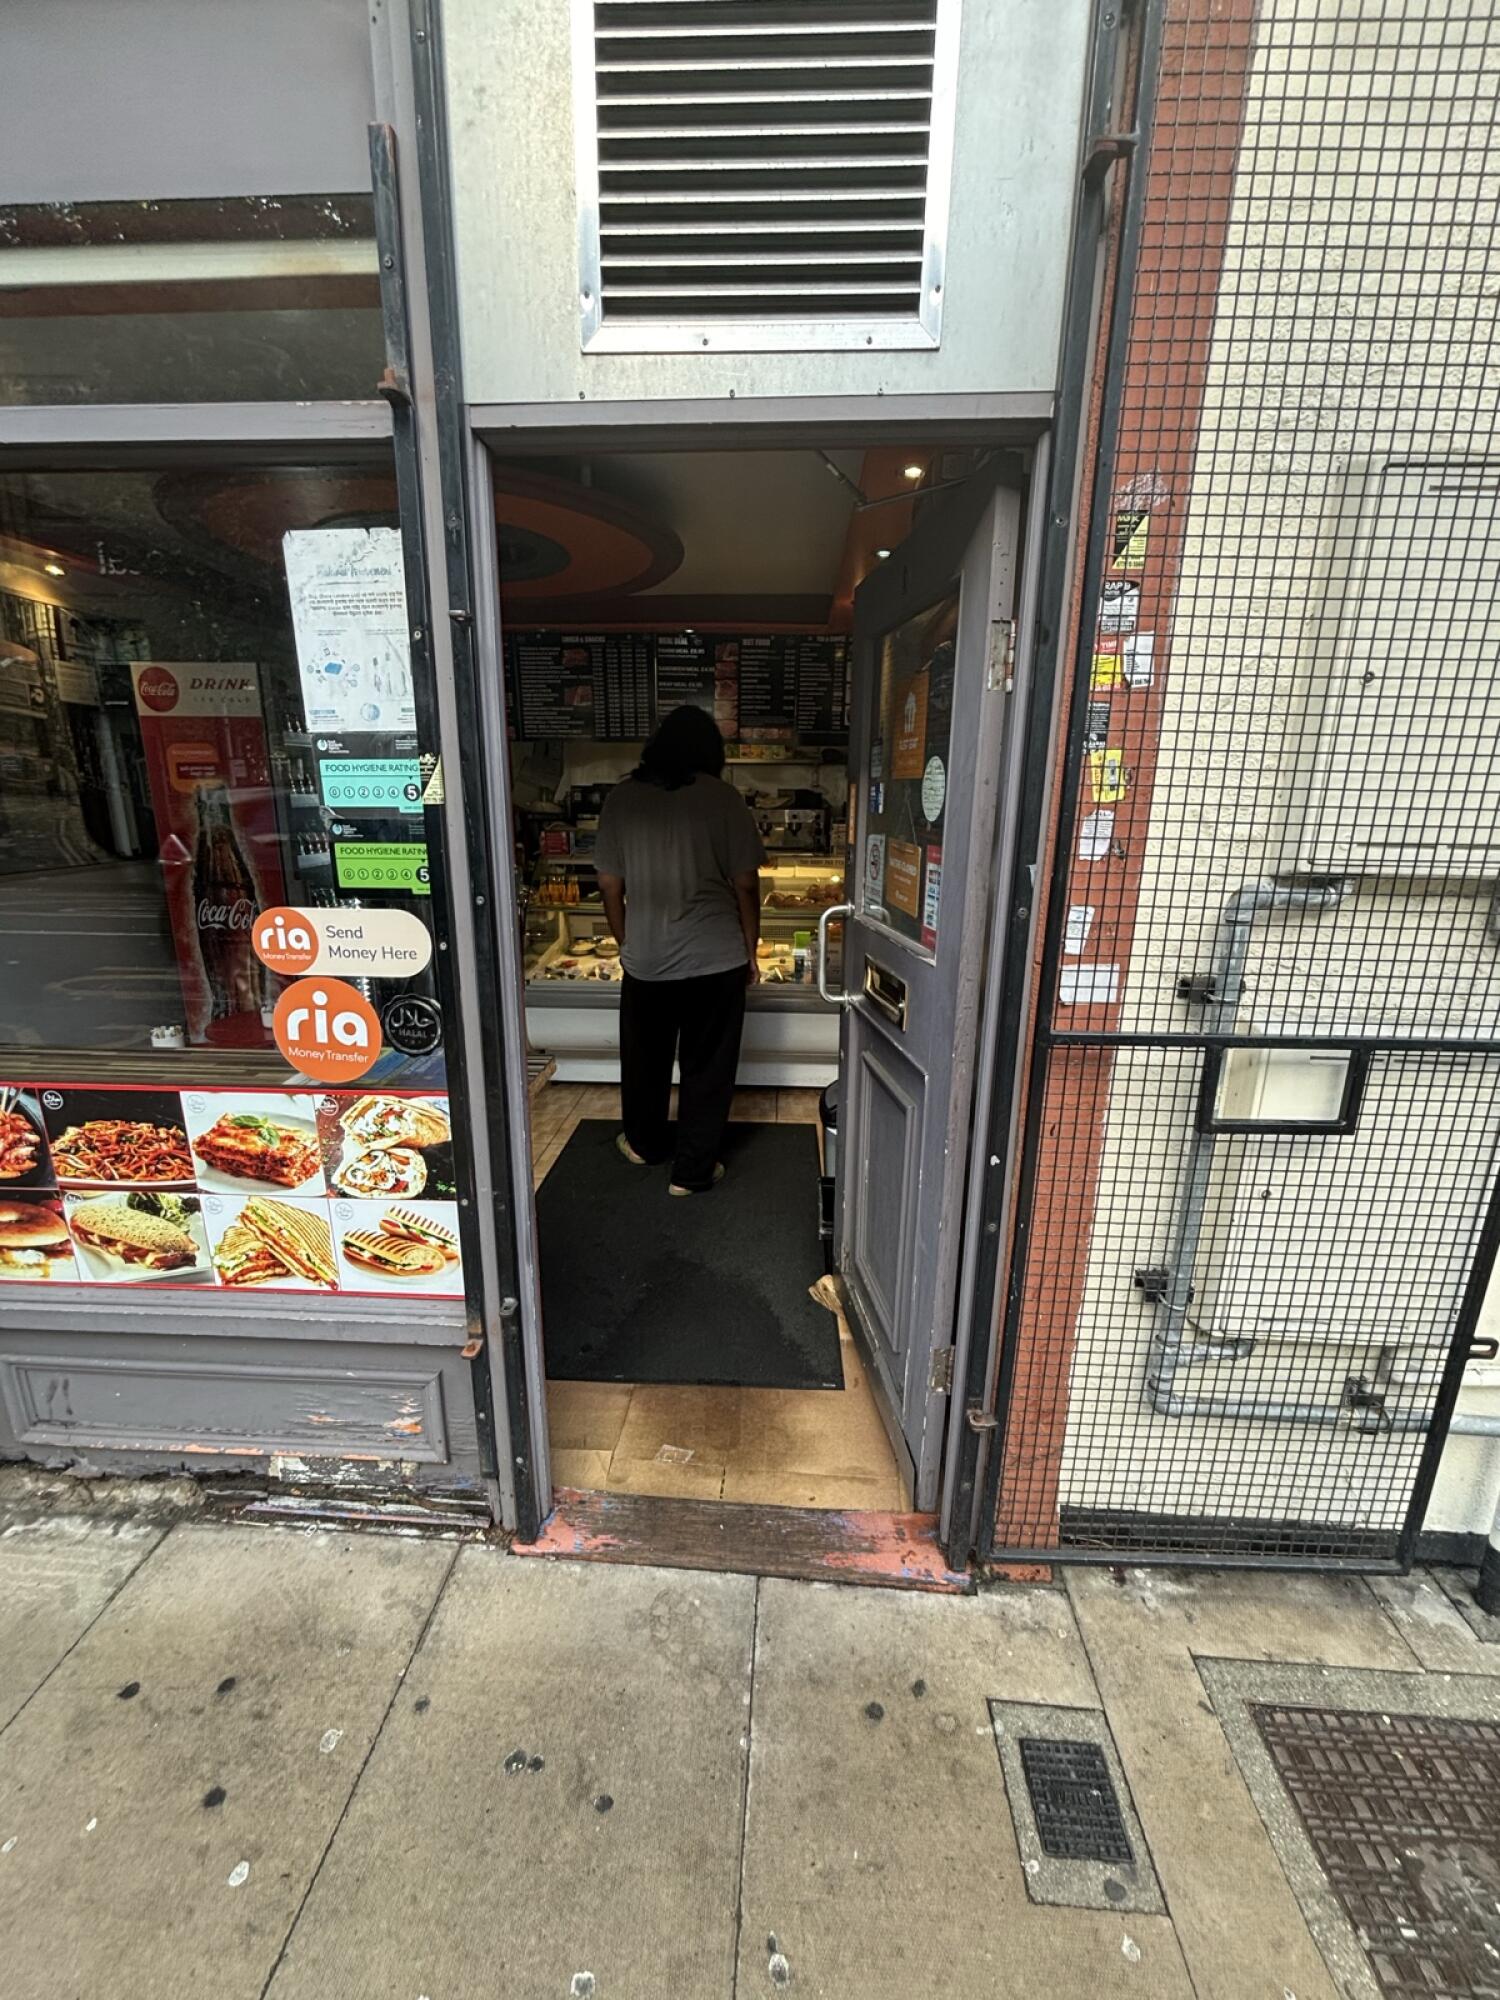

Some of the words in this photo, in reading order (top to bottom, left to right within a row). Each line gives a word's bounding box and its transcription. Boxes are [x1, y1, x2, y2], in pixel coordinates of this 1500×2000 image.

[1104, 581, 1131, 590] RAPD
[325, 764, 350, 772] FOOD
[352, 764, 387, 772] HYGIENE
[389, 764, 418, 772] RATING
[407, 785, 417, 800] 5
[340, 847, 365, 855] FOOD
[367, 847, 401, 855] HYGIENE
[420, 868, 430, 882] 5
[260, 916, 311, 950] ria
[325, 925, 363, 939] Send
[328, 945, 377, 962] Money
[382, 946, 418, 960] Here
[286, 990, 368, 1047] ria
[399, 1029, 427, 1038] HALAL
[288, 1047, 325, 1062] Money
[326, 1050, 369, 1064] Transfer
